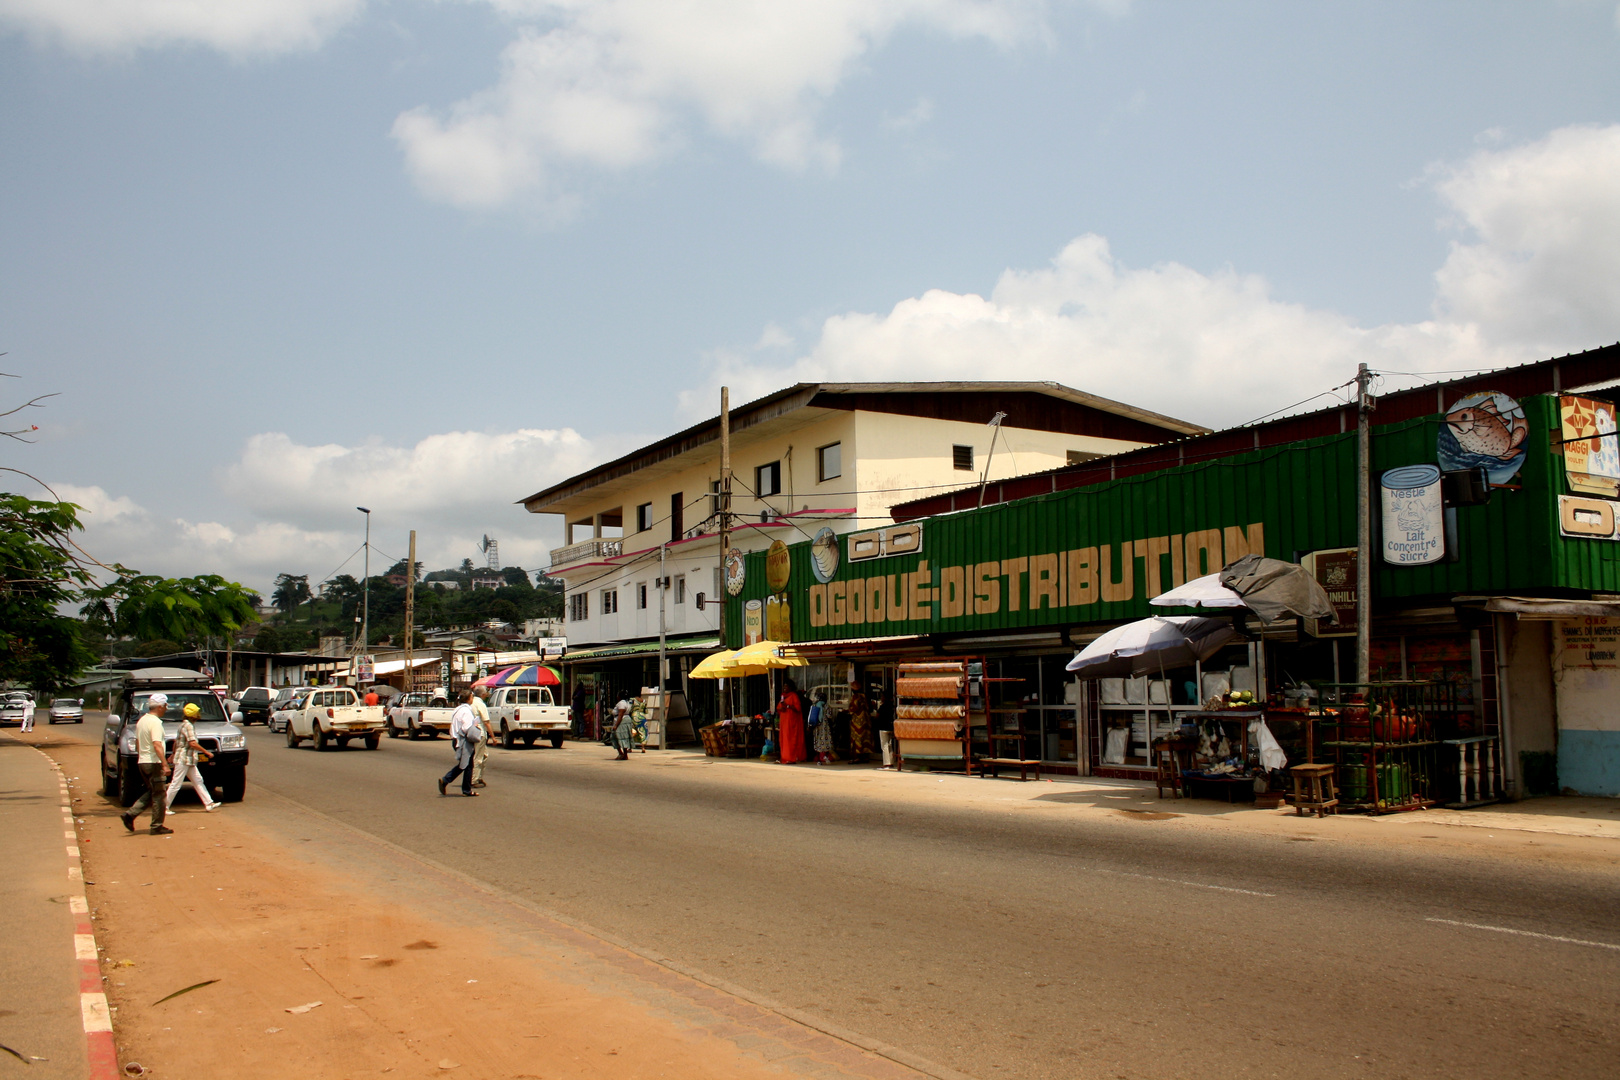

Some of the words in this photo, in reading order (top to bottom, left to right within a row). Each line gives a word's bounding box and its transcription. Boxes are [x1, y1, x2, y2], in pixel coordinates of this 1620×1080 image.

[1564, 441, 1589, 456] MAGGI
[1406, 529, 1426, 542] Lait
[746, 615, 759, 626] NIDO
